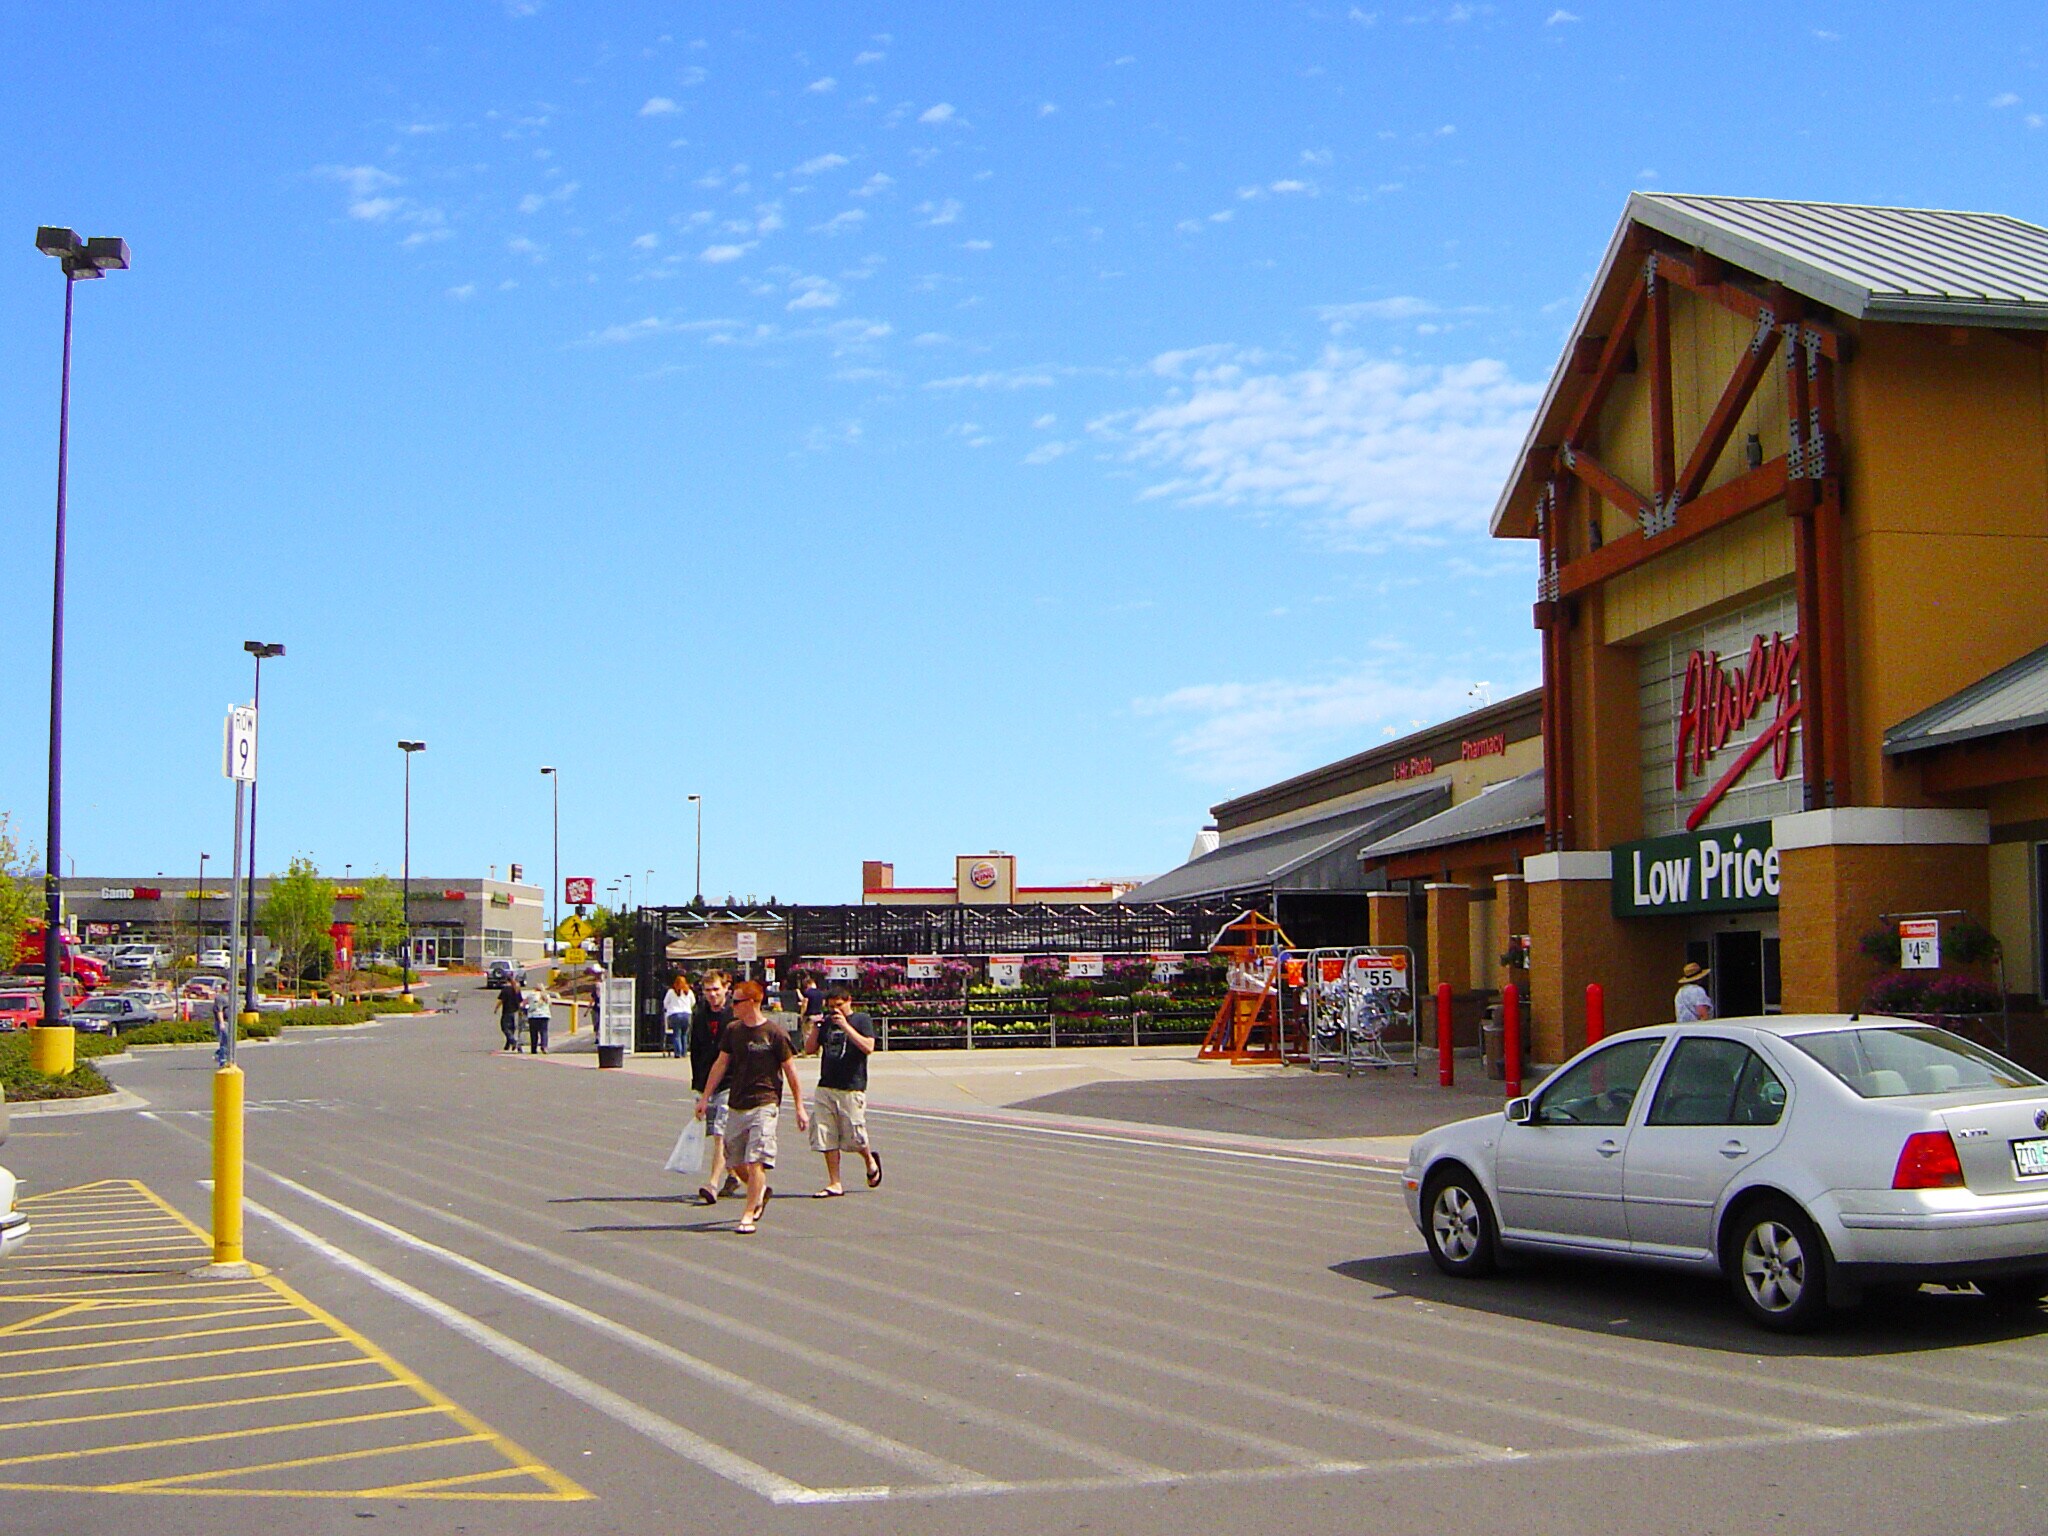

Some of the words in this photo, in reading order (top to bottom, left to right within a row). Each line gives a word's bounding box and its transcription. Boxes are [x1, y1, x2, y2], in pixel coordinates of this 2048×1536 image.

[1675, 631, 1800, 802] Alway
[240, 738, 249, 775] 9
[1462, 732, 1505, 760] Pharmacy
[1633, 850, 1691, 906] Low
[1364, 970, 1392, 986] $55
